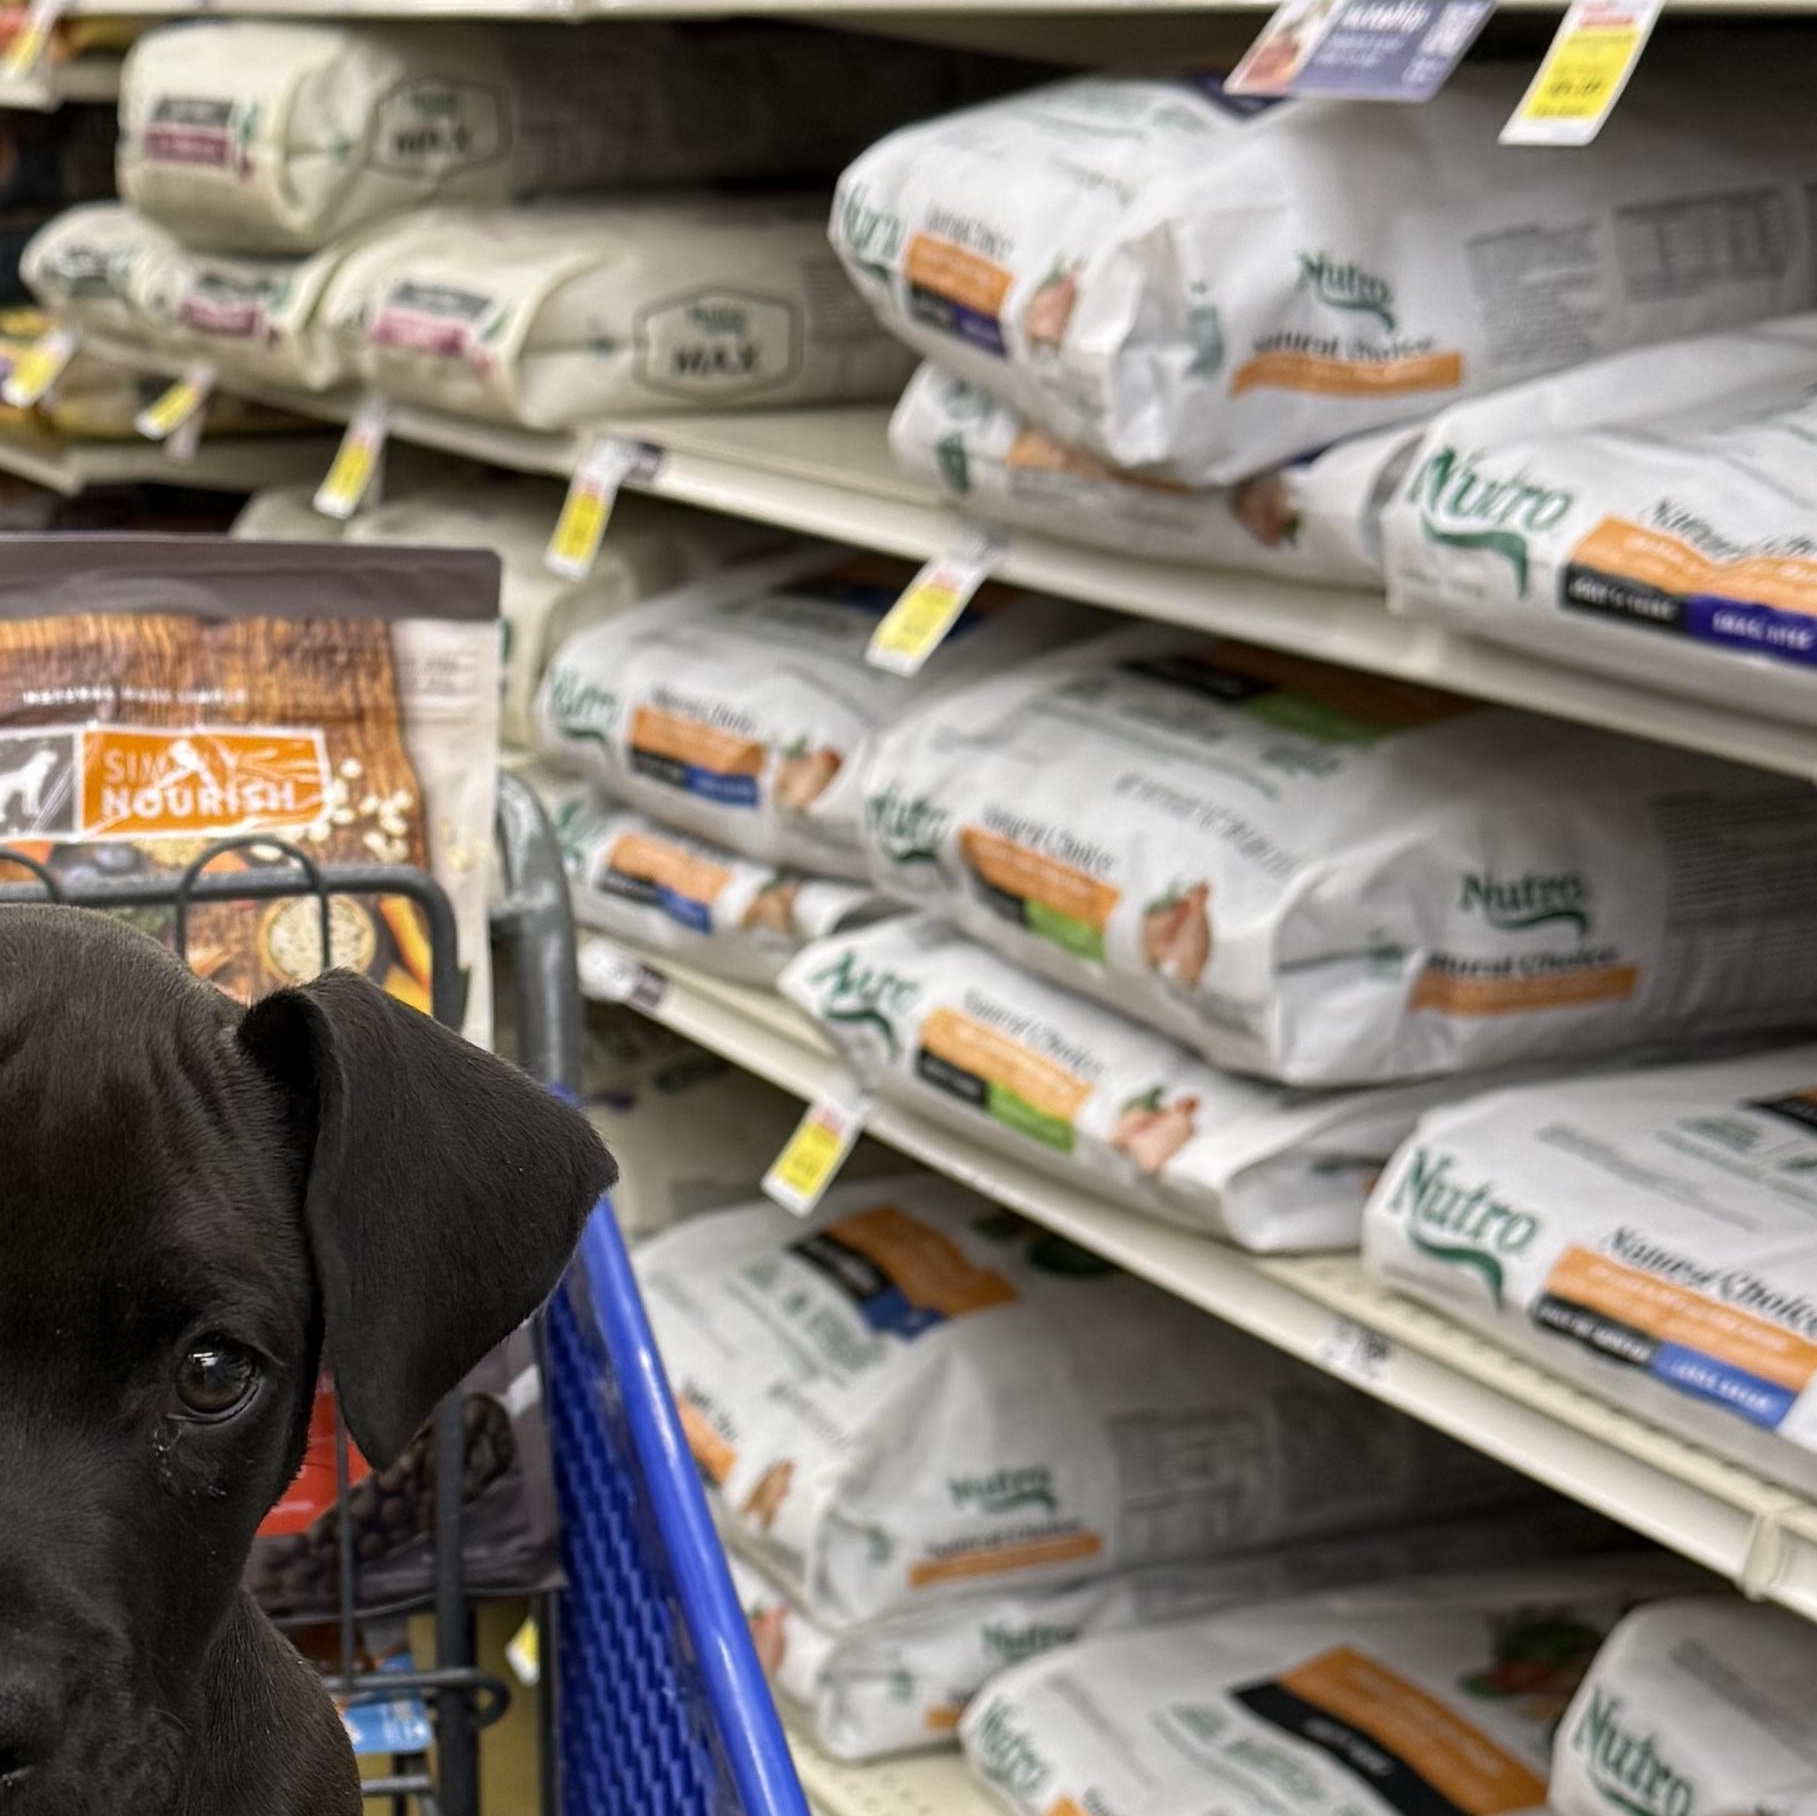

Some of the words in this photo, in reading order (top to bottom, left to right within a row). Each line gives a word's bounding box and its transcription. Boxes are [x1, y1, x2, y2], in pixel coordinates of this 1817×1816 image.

[1410, 449, 1575, 531] Nutro
[102, 780, 298, 821] NOURISH
[1388, 1145, 1540, 1254] Nutro
